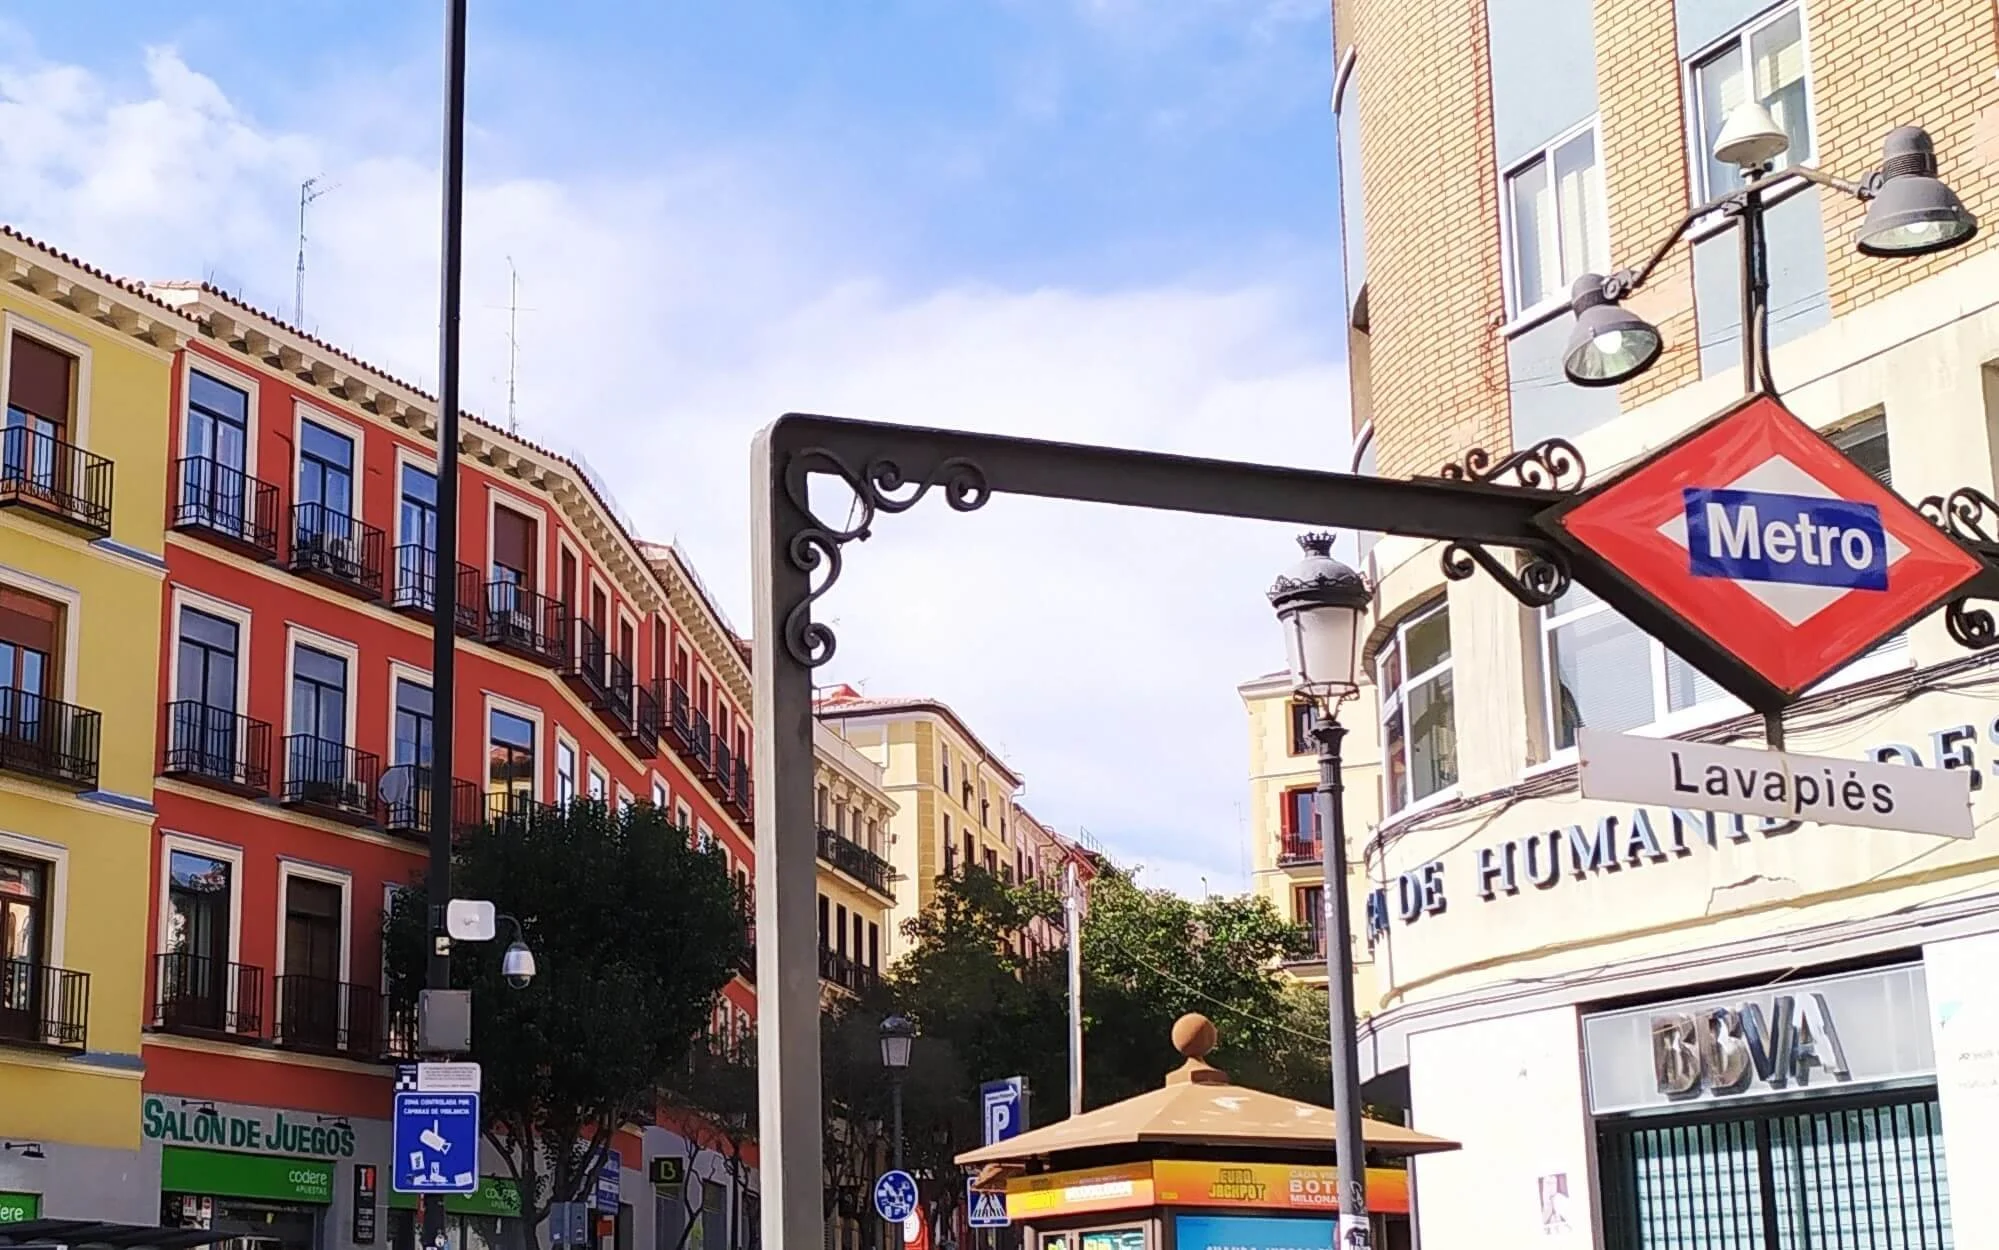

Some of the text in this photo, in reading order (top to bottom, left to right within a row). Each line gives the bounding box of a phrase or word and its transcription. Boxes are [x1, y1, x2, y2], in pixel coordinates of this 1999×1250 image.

[1706, 502, 1873, 570] Metro
[1671, 751, 1895, 815] Lavapiés
[1398, 861, 1447, 926] DE
[1652, 992, 1852, 1101] BBVA
[230, 1118, 261, 1149] DE
[265, 1113, 356, 1157] JUEGOS
[992, 1105, 1010, 1144] P
[289, 1168, 328, 1185] codere
[1208, 1183, 1266, 1200] JACKPOT
[1220, 1169, 1252, 1184] EURO
[0, 1204, 24, 1221] ere
